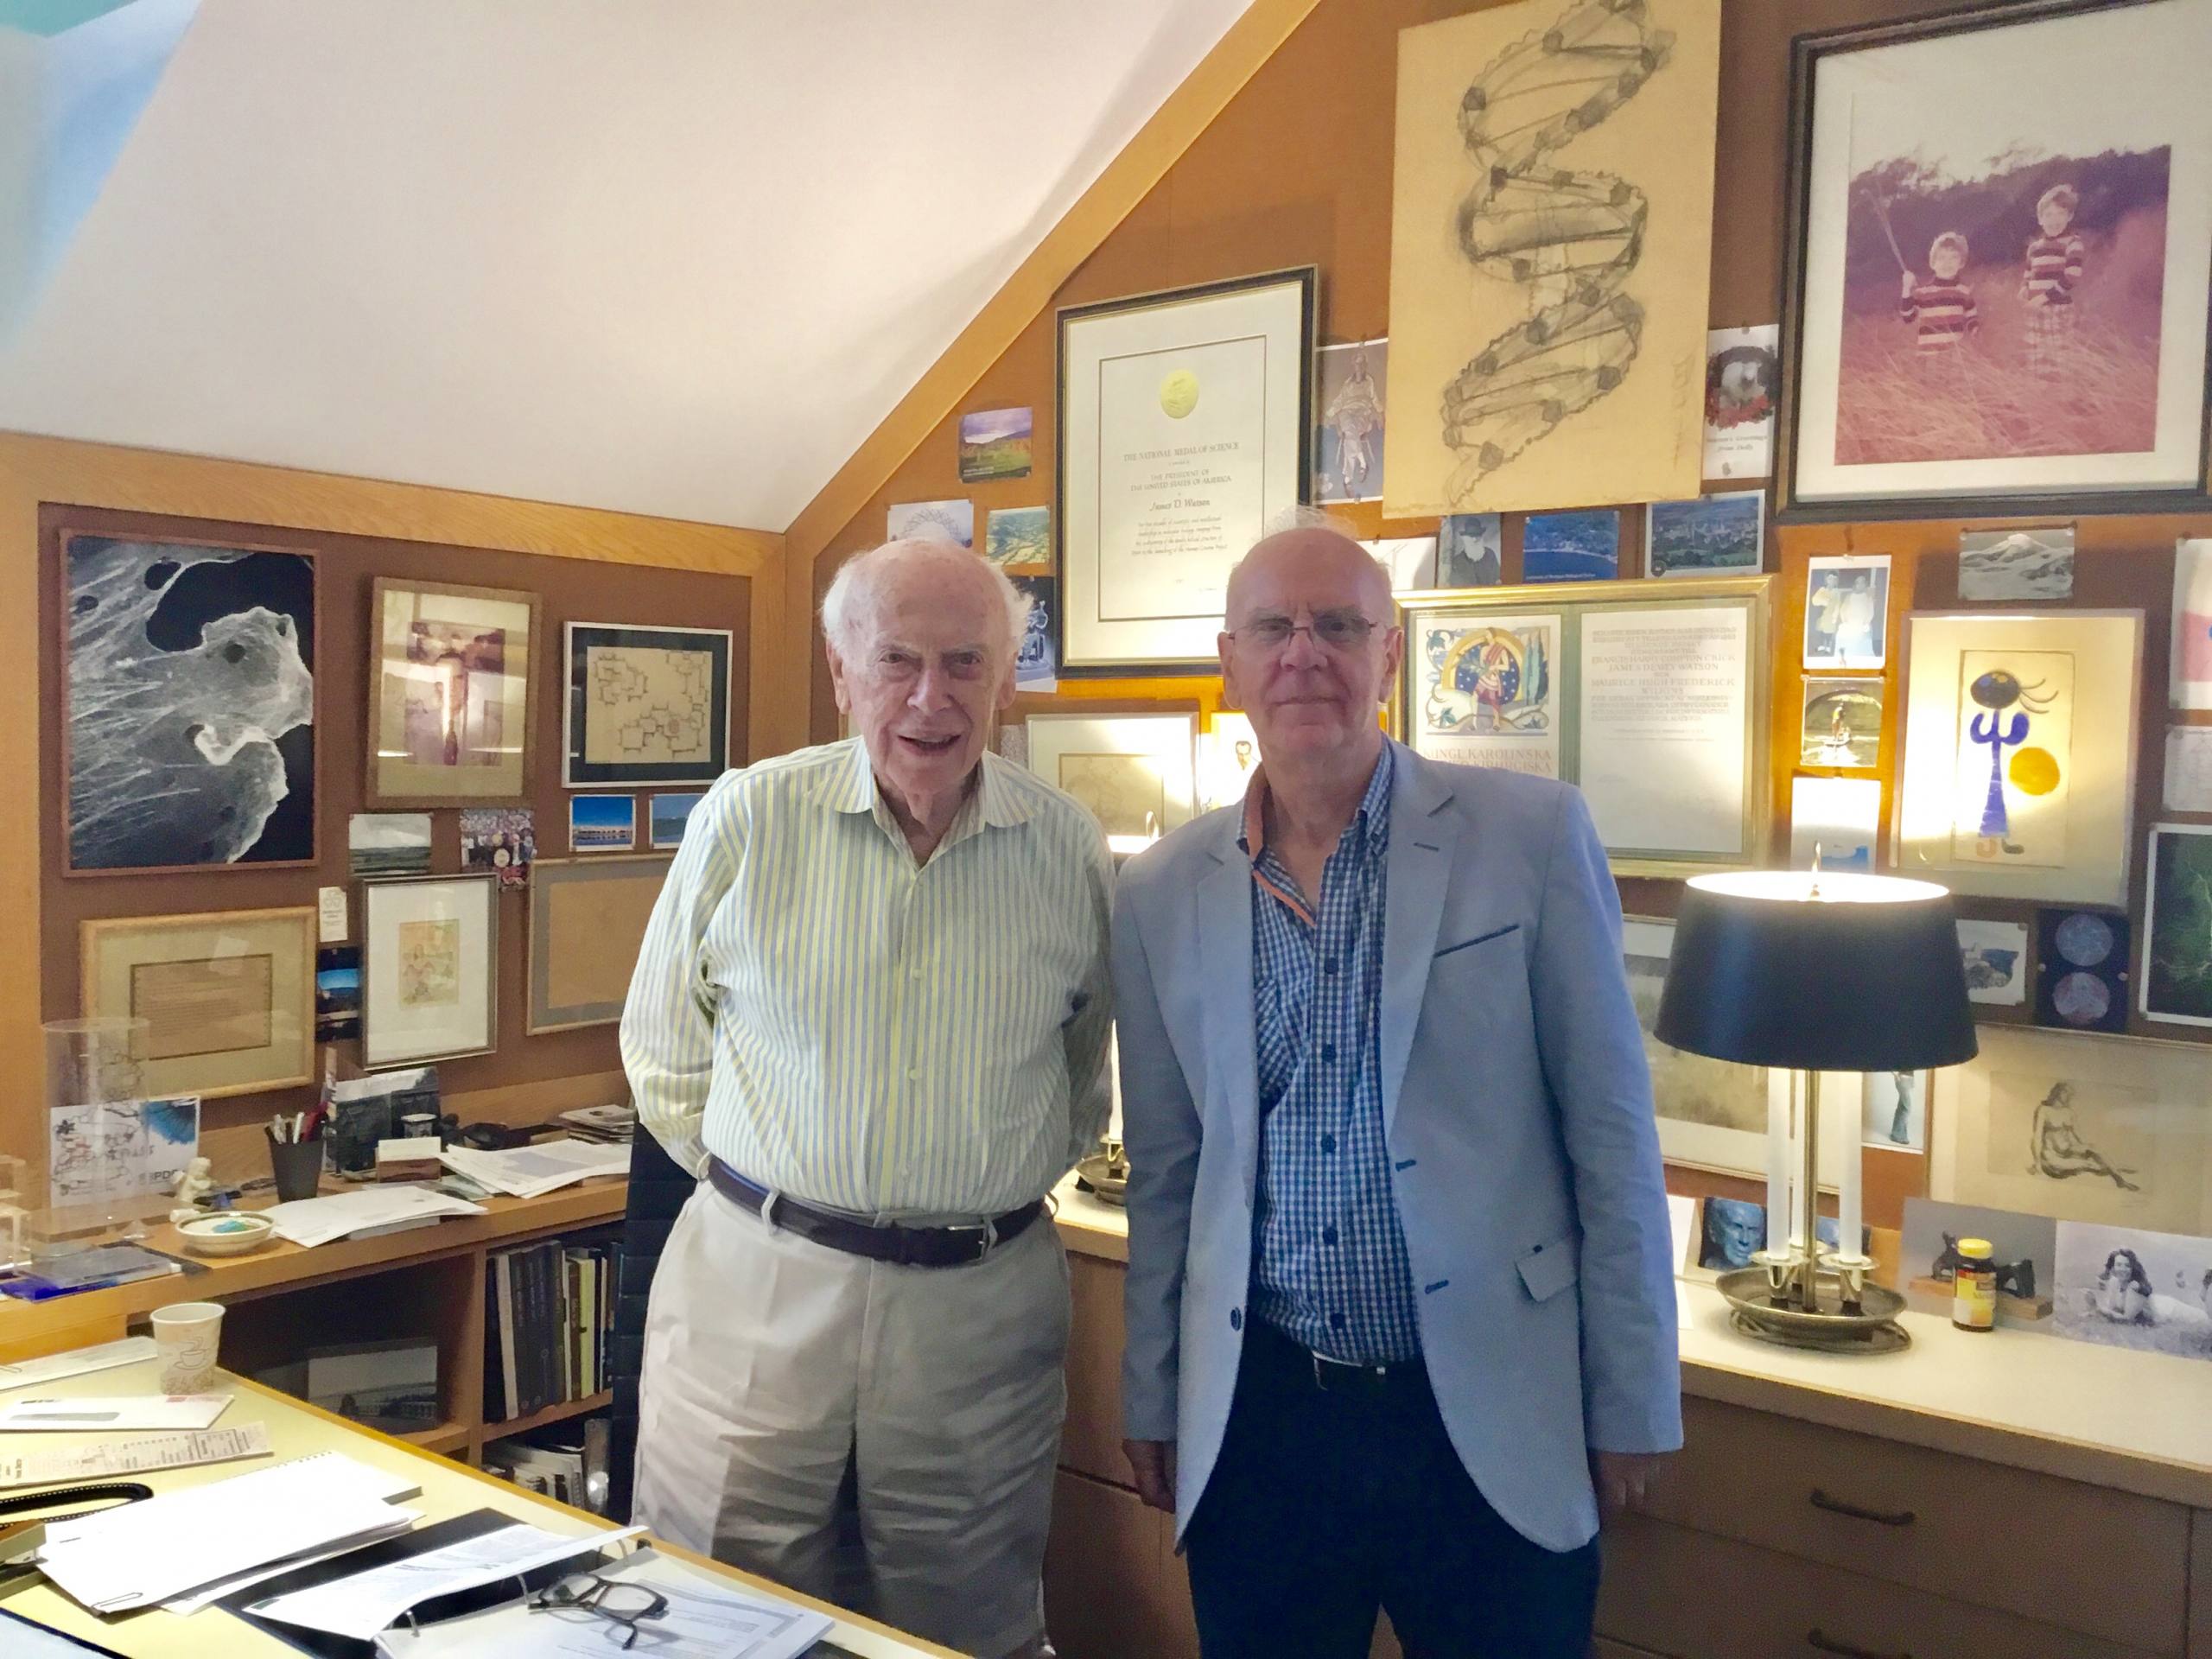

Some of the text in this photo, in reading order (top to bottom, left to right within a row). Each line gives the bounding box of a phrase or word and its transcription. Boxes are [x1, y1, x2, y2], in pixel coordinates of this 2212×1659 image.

[1139, 448, 1173, 460] NATIONAL
[1173, 446, 1198, 456] MEDAL
[1209, 442, 1240, 452] SCIENCE
[1468, 747, 1553, 761] KAROLINSKA
